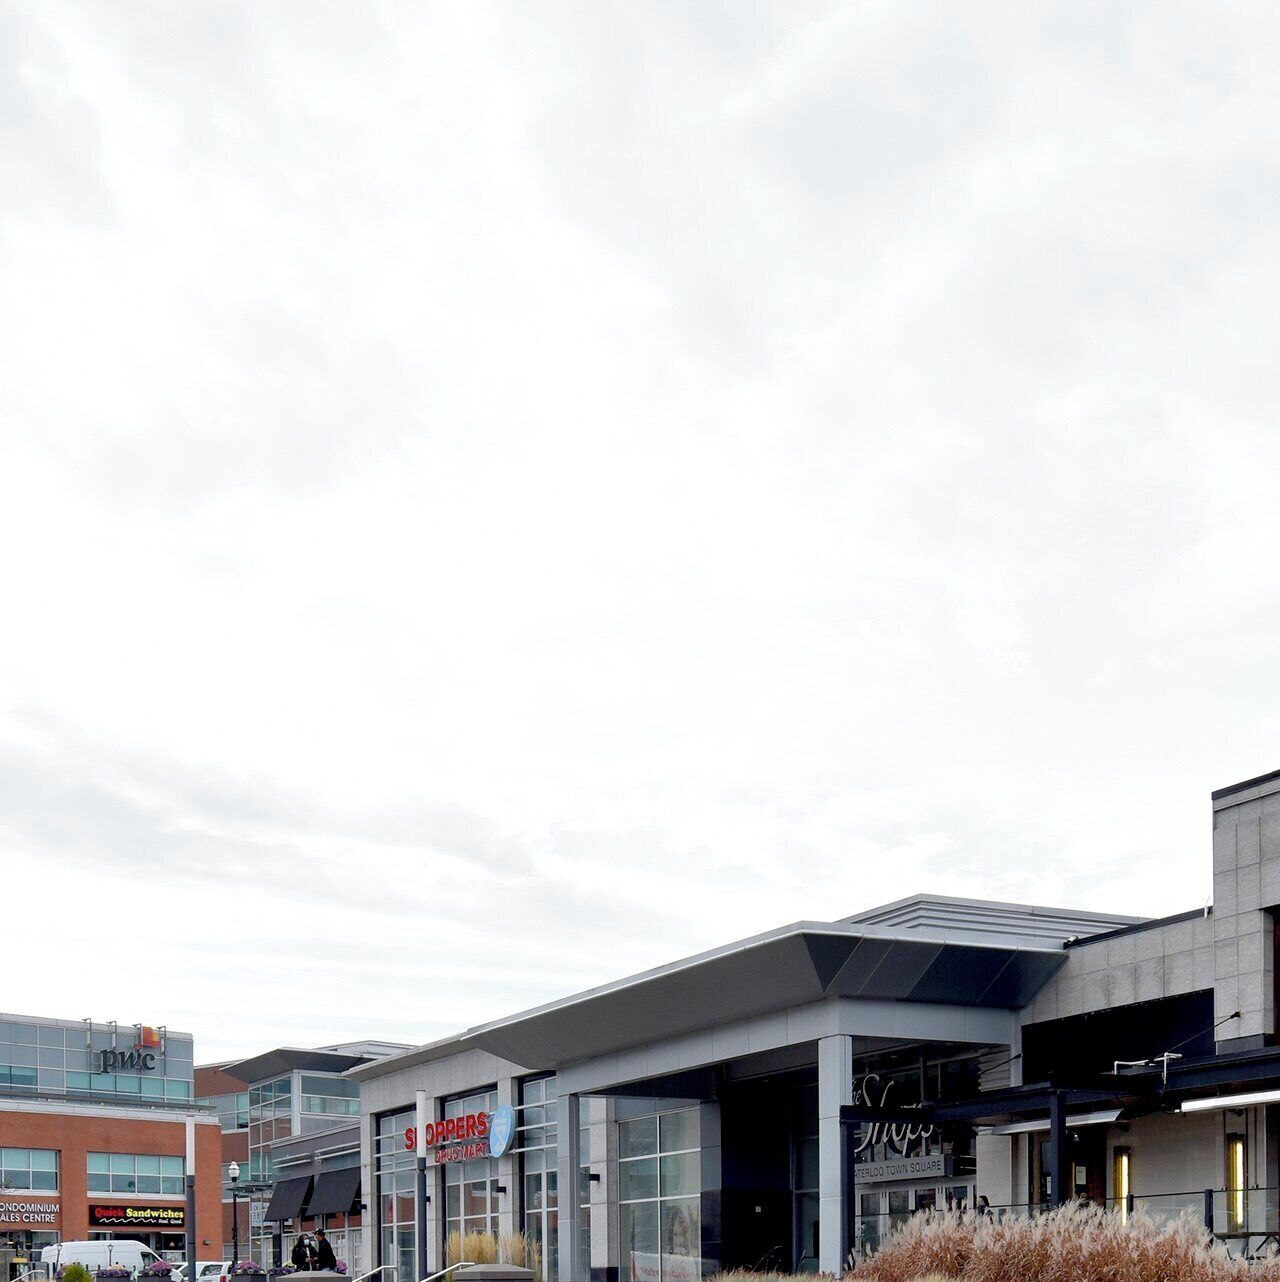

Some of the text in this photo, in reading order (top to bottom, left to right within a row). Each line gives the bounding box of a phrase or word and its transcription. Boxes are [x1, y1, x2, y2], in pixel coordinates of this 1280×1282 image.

[100, 1048, 156, 1074] pwc
[404, 1111, 488, 1150] SOPPERS
[885, 1164, 908, 1175] TOWN
[909, 1160, 941, 1173] SQUARE
[22, 1213, 56, 1223] CENTRE
[95, 1207, 184, 1219] Quick Sandwiches
